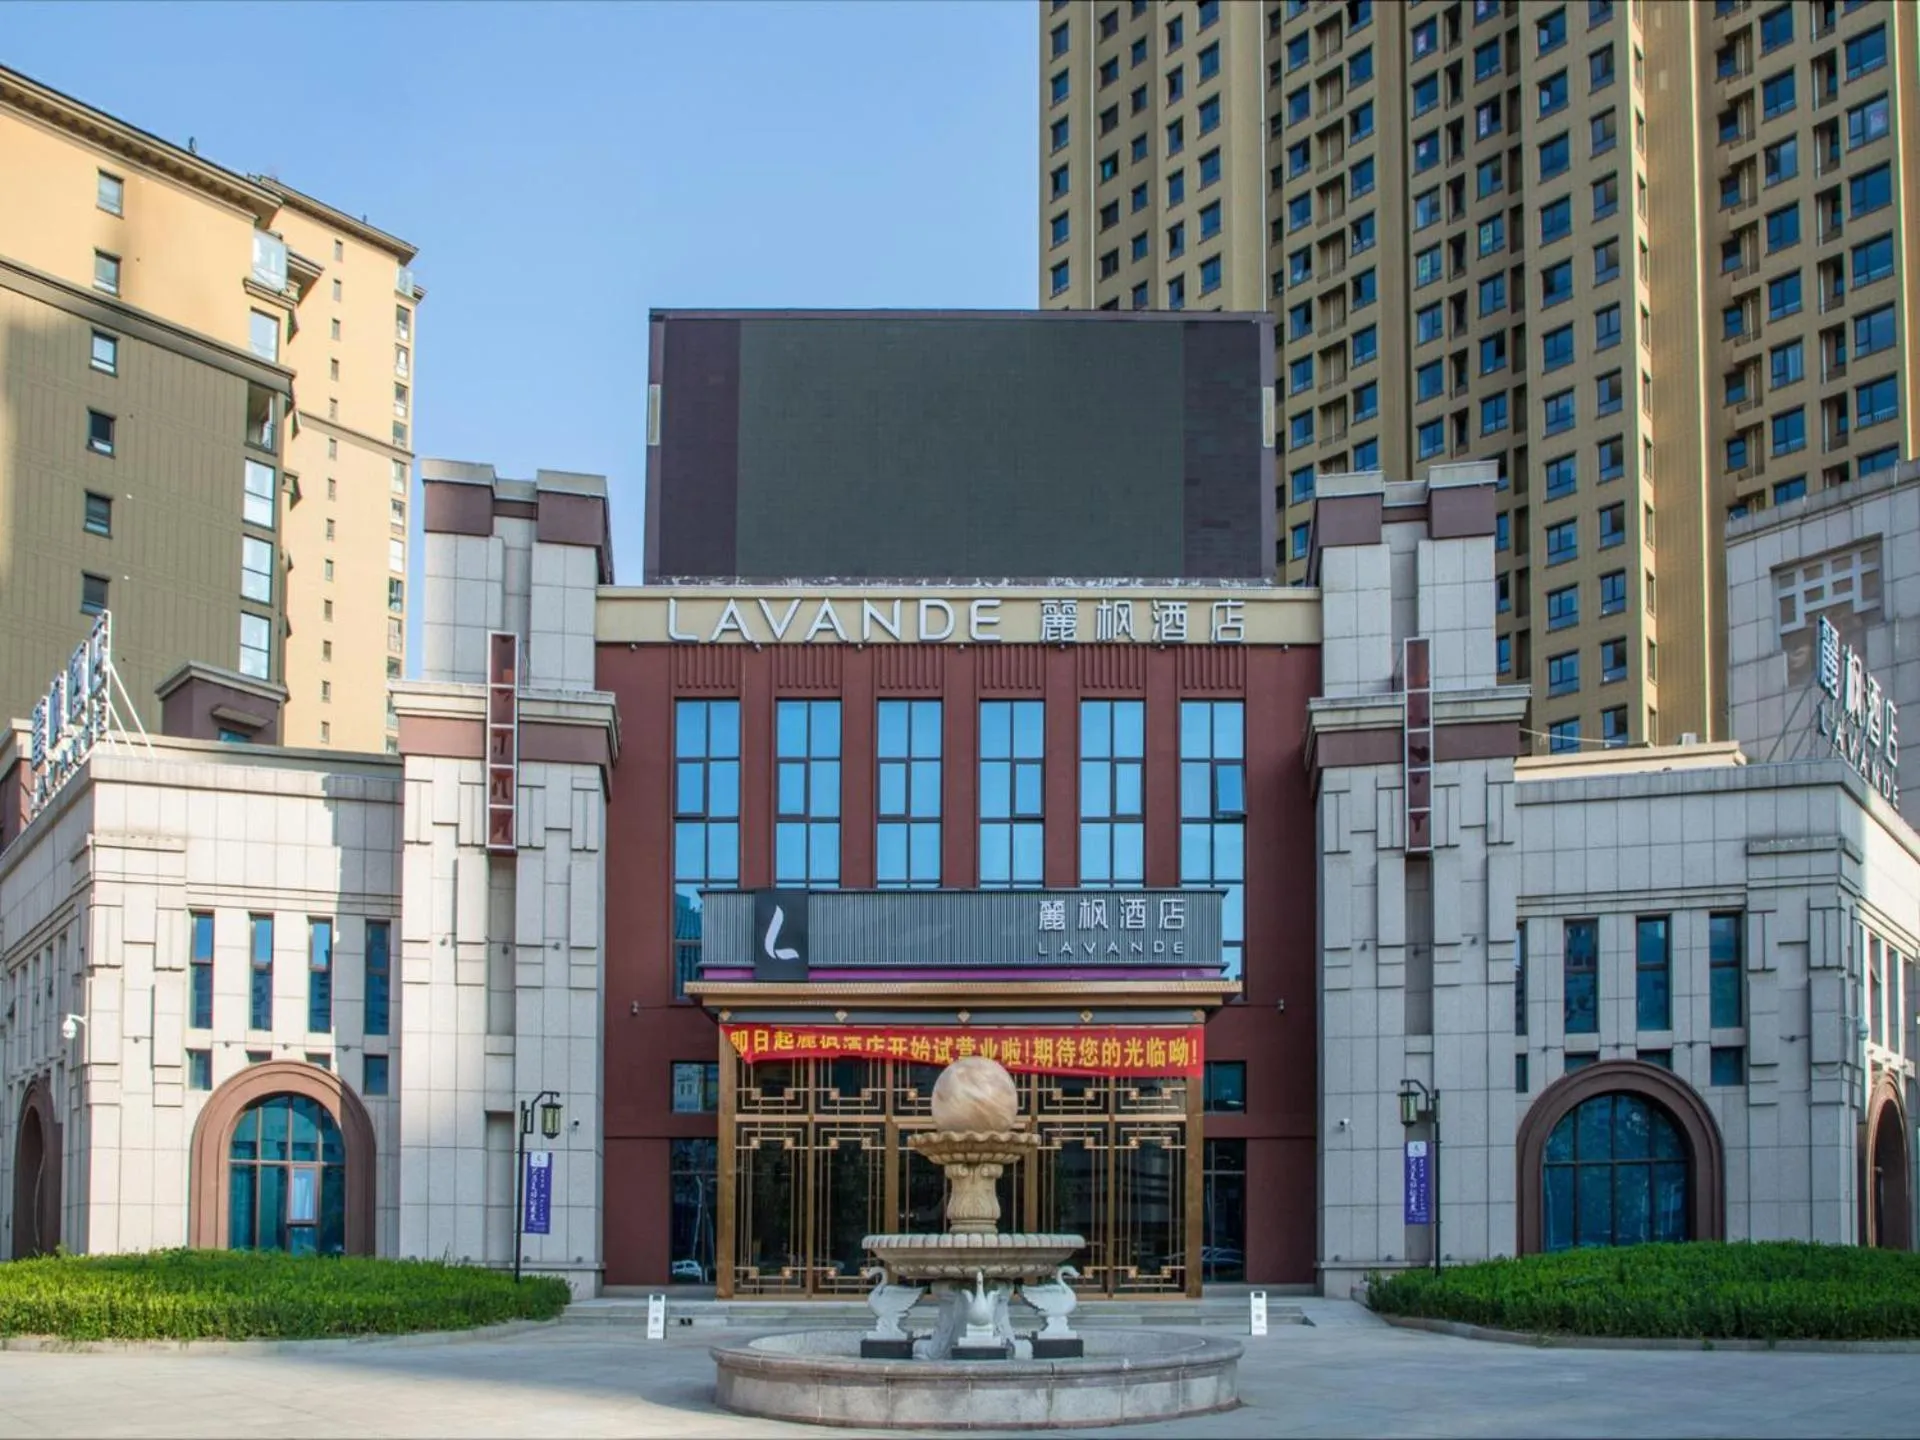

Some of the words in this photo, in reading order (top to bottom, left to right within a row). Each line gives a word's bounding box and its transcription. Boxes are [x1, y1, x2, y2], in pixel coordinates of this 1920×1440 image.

[667, 598, 1001, 642] LAVANDE
[1040, 598, 1246, 643] 麗枫酒店
[1038, 895, 1186, 931] 麗枫酒店
[1038, 940, 1185, 954] LAVANDE
